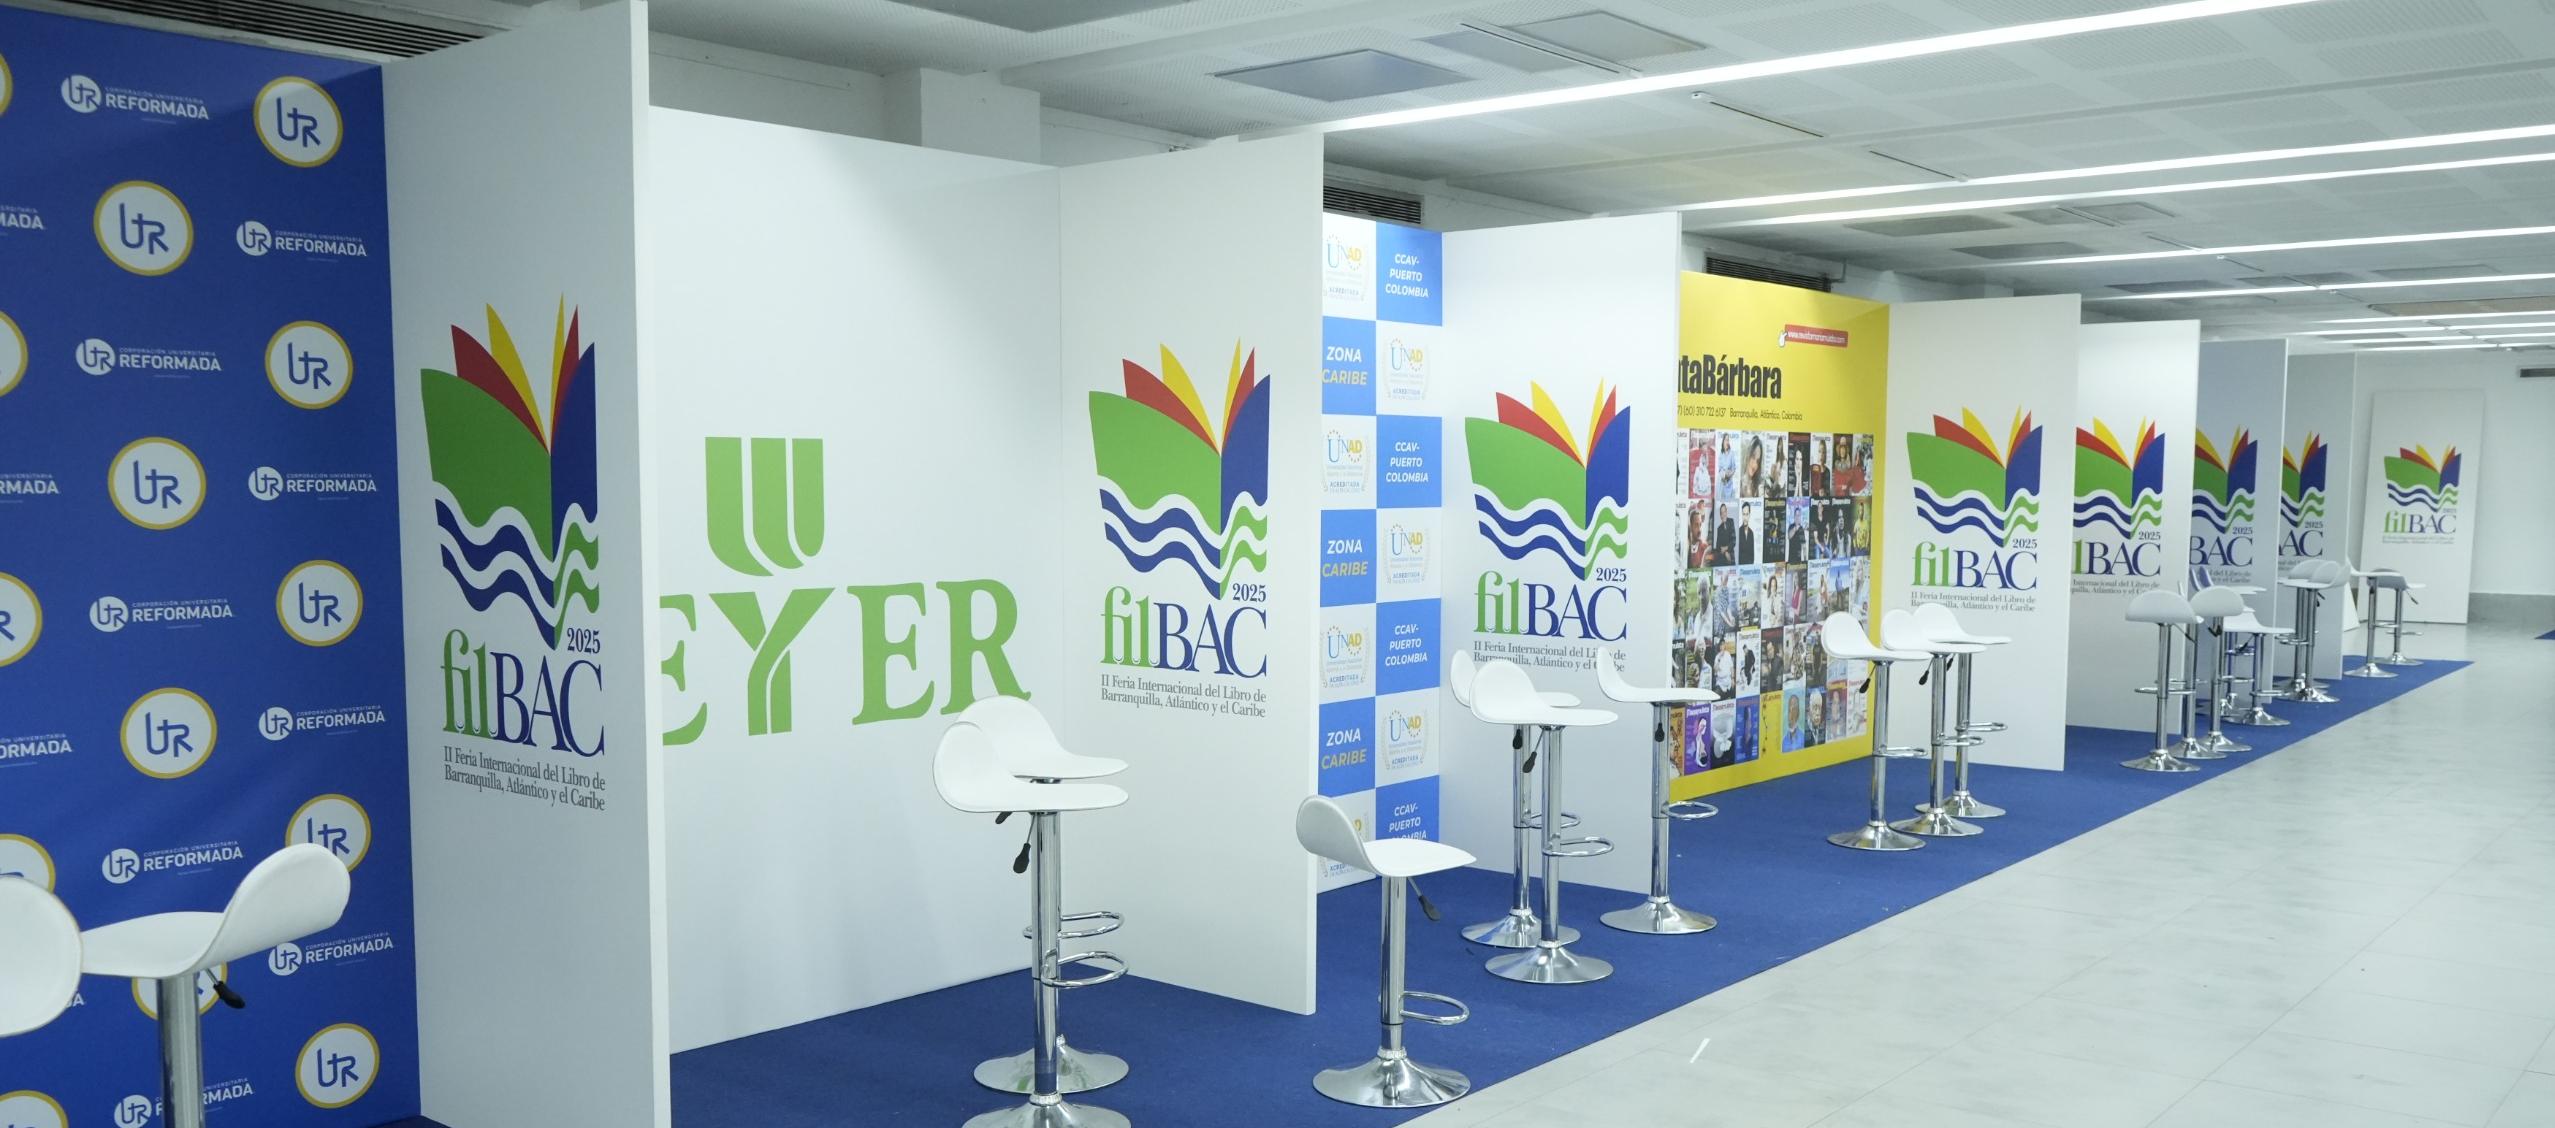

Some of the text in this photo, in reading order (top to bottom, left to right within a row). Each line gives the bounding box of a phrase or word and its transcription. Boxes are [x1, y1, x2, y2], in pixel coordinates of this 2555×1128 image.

[105, 93, 209, 120] REFORMADA
[275, 237, 367, 256] REFORMADA
[1389, 268, 1422, 281] PUERTO
[1385, 283, 1429, 298] COLOMBIA
[119, 354, 222, 371] REFORMADA
[1326, 346, 1362, 363] ZONA
[1322, 368, 1368, 385] CARIBE
[1390, 457, 1422, 467] PUERTO
[286, 479, 377, 492] REFORMADA
[1386, 472, 1429, 483] COLOMBIA
[2138, 531, 2161, 540] 2025
[2232, 527, 2253, 535] 2025
[1327, 539, 1362, 554] ZONA
[2012, 538, 2037, 549] 2025
[1322, 561, 1368, 577] CARIBE
[1596, 568, 1627, 582] 2025
[1232, 583, 1266, 602] 2025
[1919, 592, 1938, 600] Feria
[1939, 592, 1989, 602] Internacional
[1990, 593, 2001, 602] del
[132, 605, 233, 622] REFORMADA
[567, 627, 600, 653] 2025
[1389, 638, 1422, 650] PUERTO
[1385, 652, 1428, 667] COLOMBIA
[1474, 641, 1481, 651] II
[1484, 641, 1506, 653] Feria
[1508, 643, 1567, 658] Internacional
[1569, 646, 1583, 658] del
[1613, 649, 1626, 661] de
[1575, 661, 1581, 672] y
[1583, 658, 1591, 670] el
[1101, 674, 1267, 703] II Feria Internacional del Libro de
[1101, 688, 1266, 718] Barranquilla, Atlántico y el Caribe
[296, 710, 385, 730] REFORMADA
[1326, 728, 1361, 746] ZONA
[1321, 748, 1367, 769] CARIBE
[443, 745, 605, 791] II Feria Internacional del Libro de
[445, 764, 605, 811] Barranquilla, Atlántico y el Caribe
[1388, 817, 1421, 832] PUERTO
[143, 846, 243, 871] REFORMADA
[305, 937, 393, 964] REFORMADA
